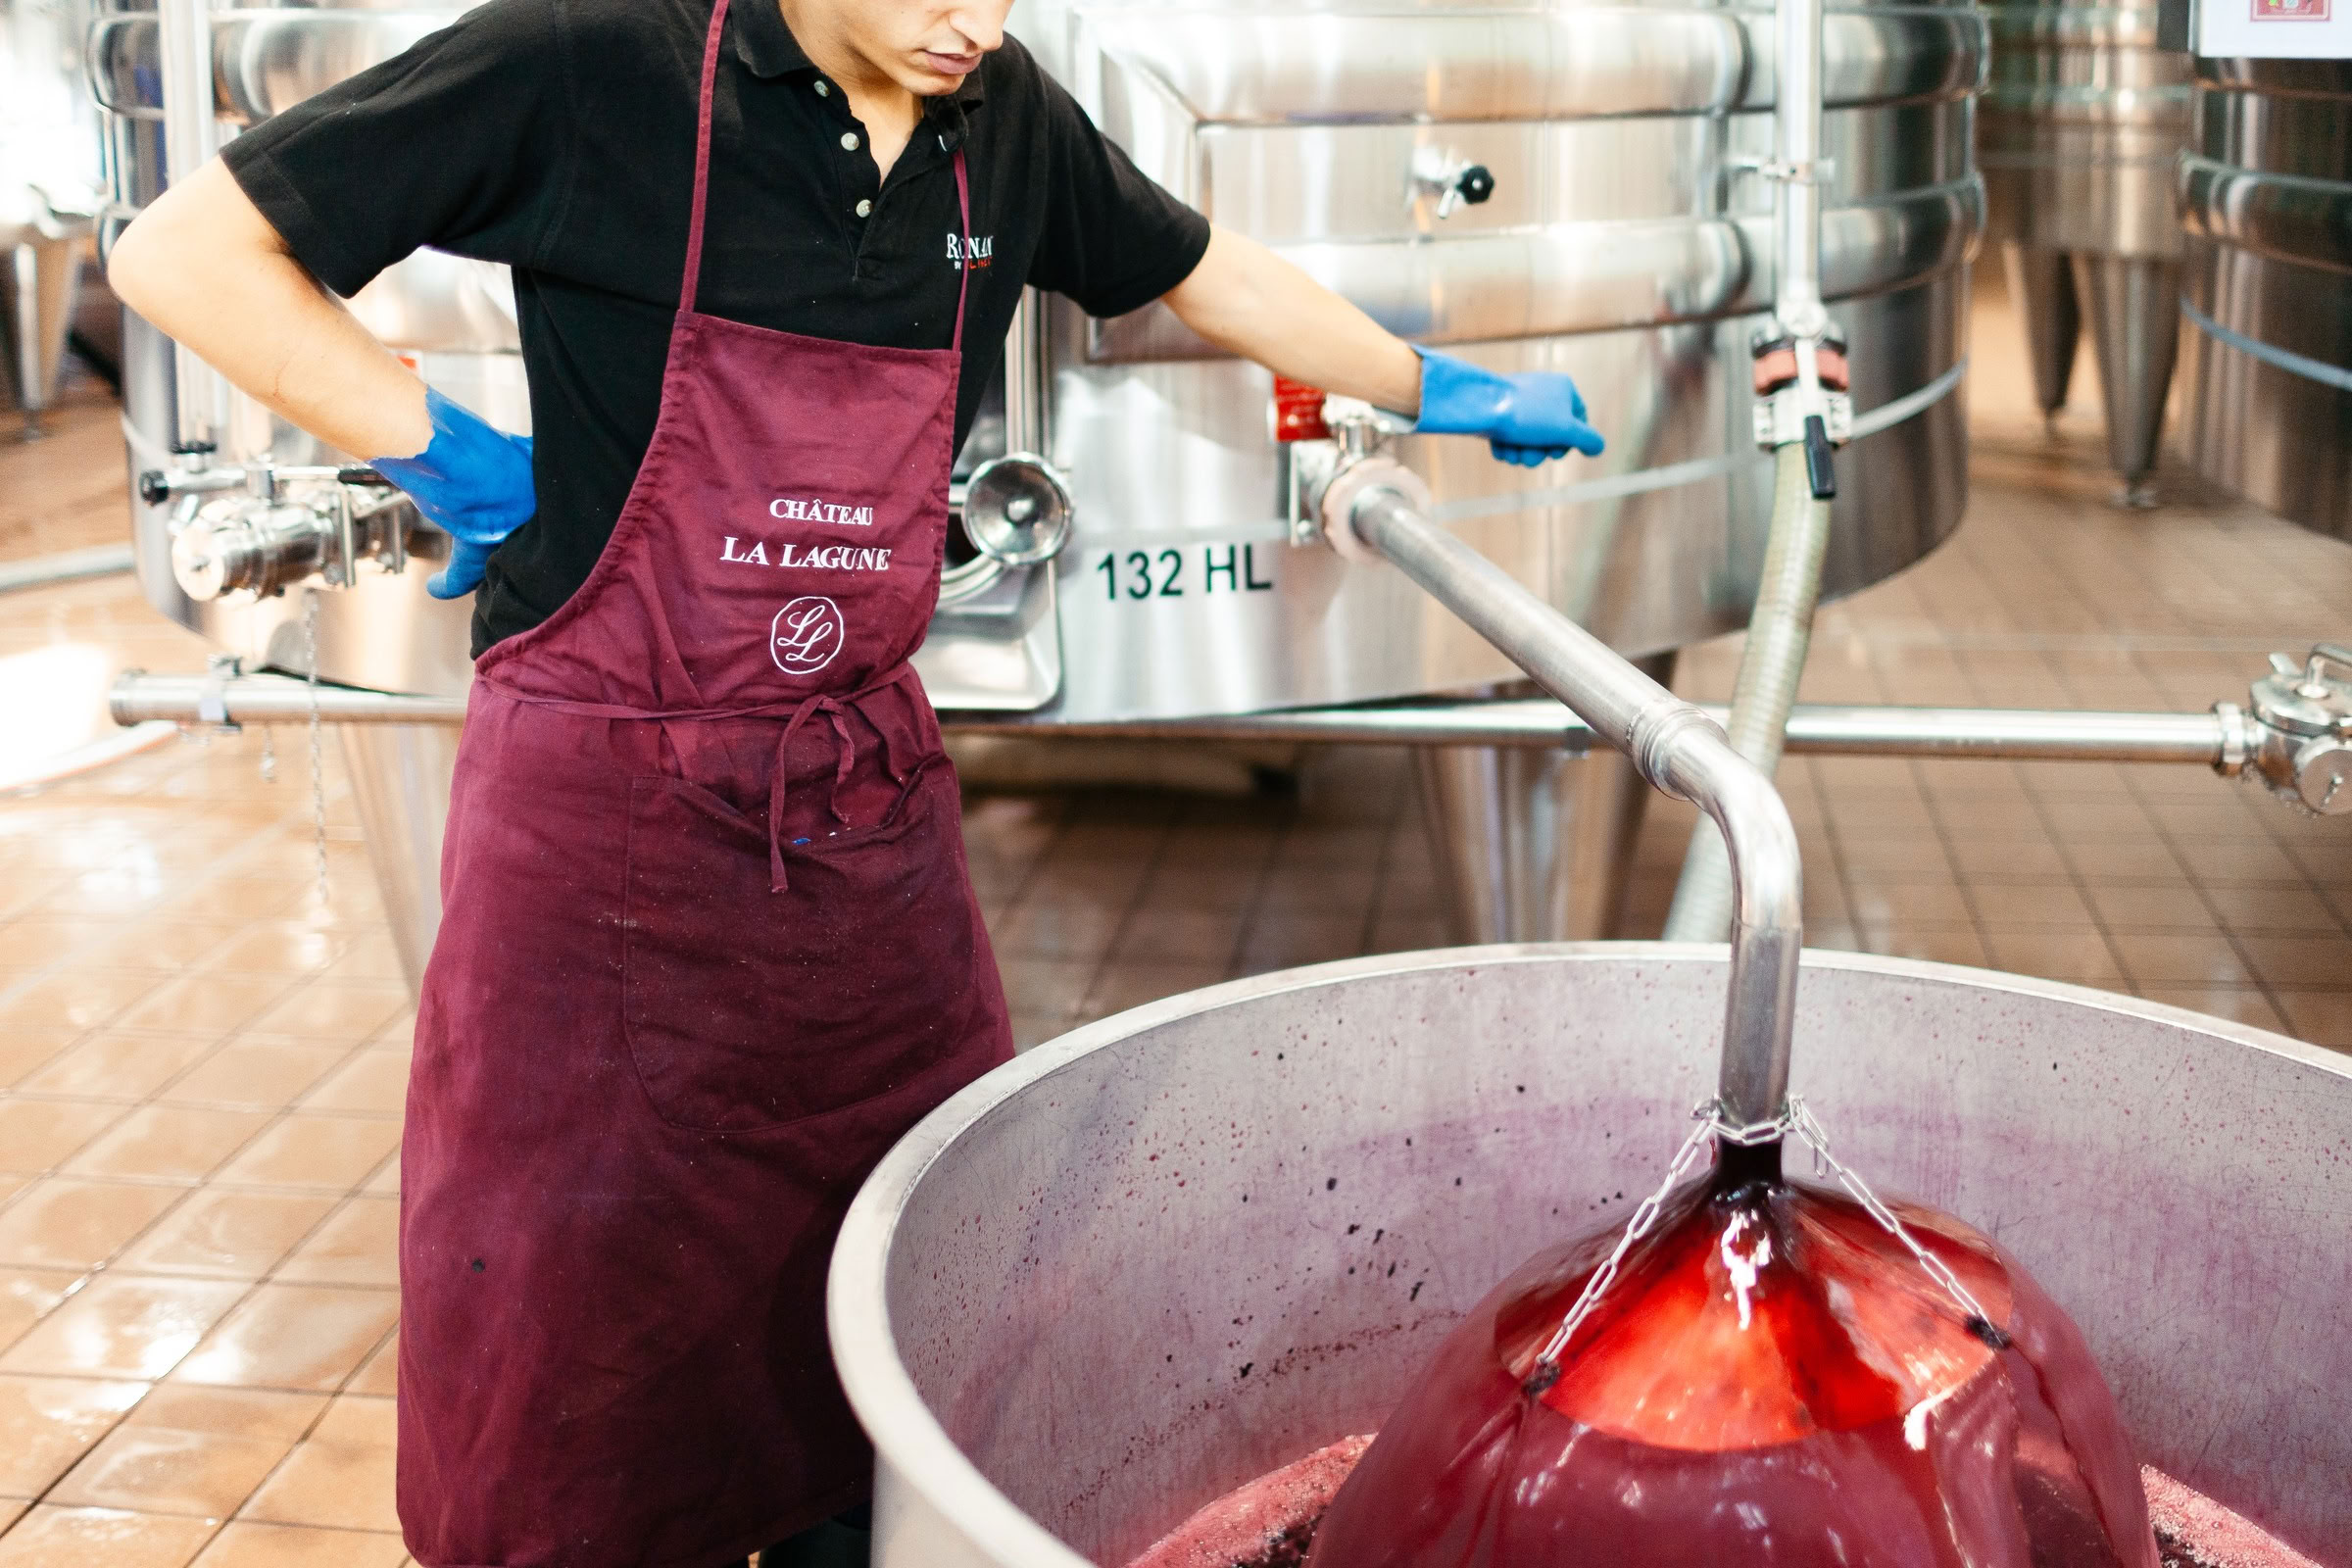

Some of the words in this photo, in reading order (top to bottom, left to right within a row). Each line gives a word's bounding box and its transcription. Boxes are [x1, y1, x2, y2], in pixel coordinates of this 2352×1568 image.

[769, 498, 874, 526] CHÂTEAU
[719, 536, 770, 565] LA
[779, 544, 892, 570] LAGUNE
[1097, 549, 1184, 601] 132
[1205, 543, 1273, 594] HL
